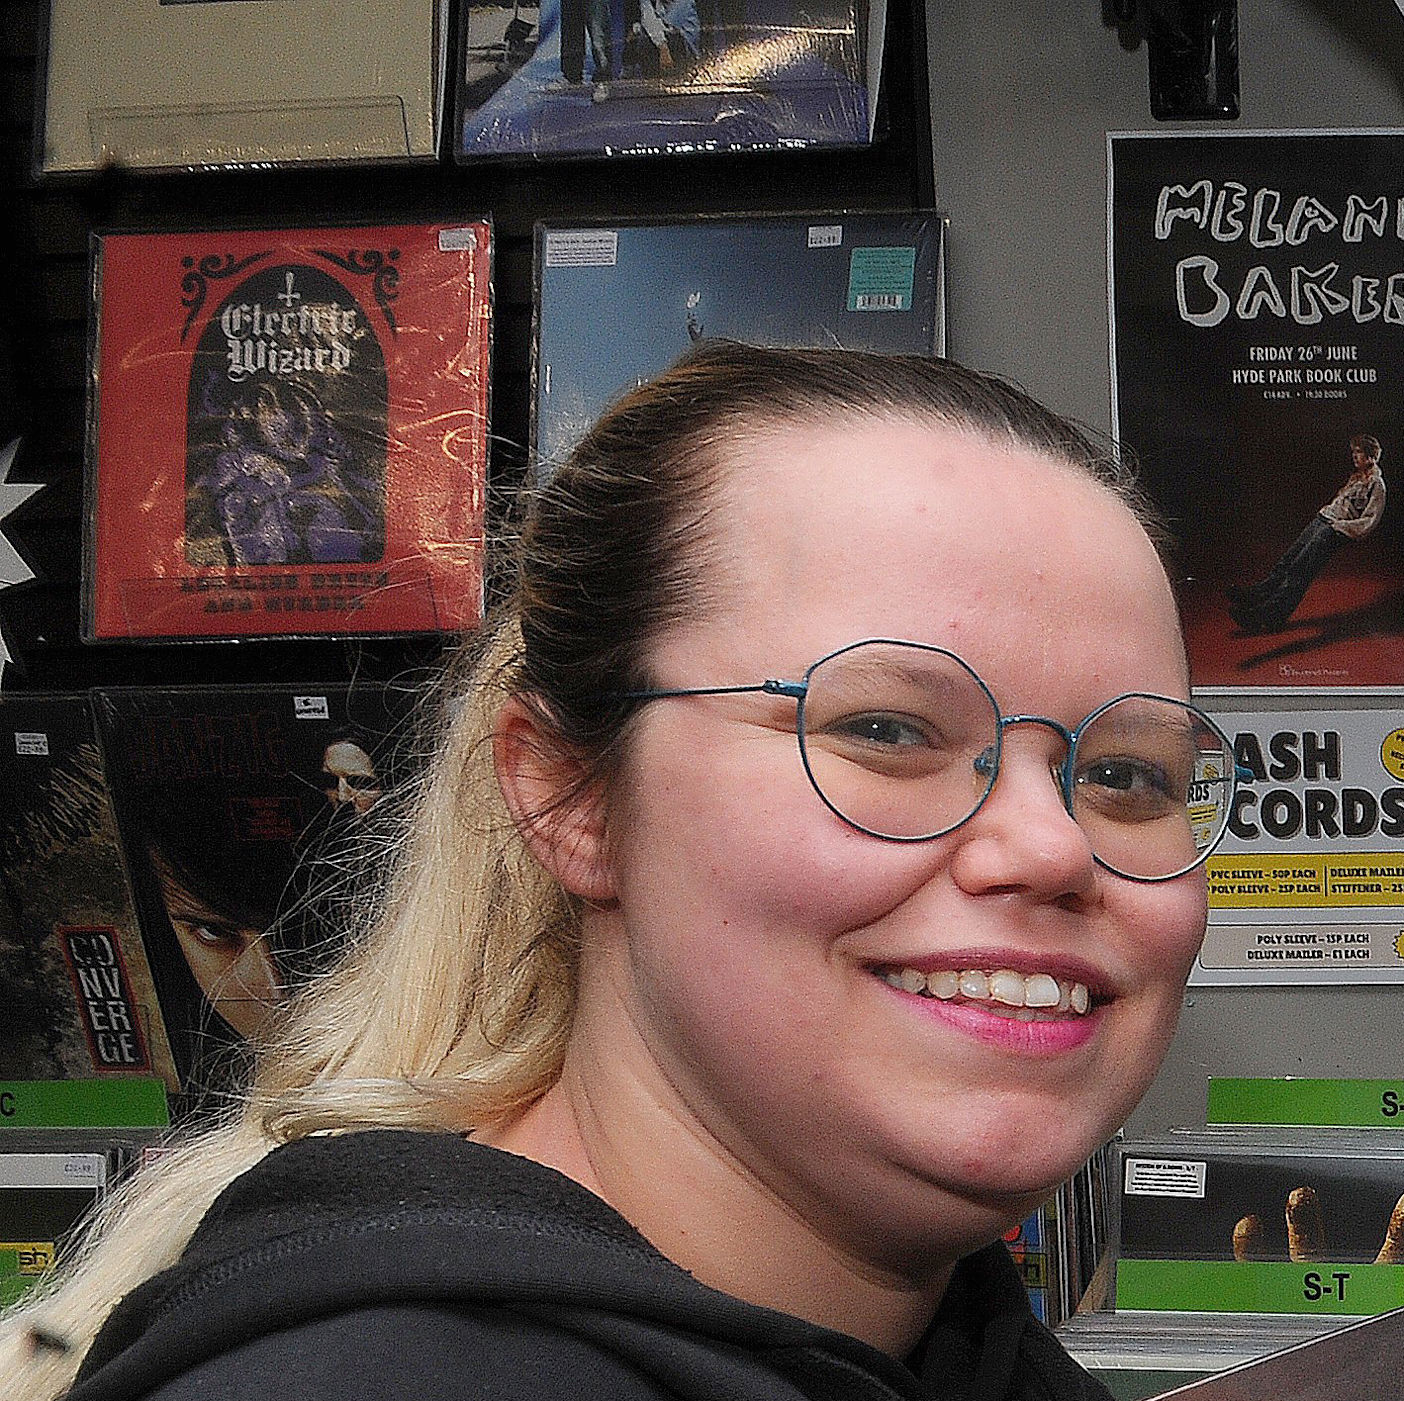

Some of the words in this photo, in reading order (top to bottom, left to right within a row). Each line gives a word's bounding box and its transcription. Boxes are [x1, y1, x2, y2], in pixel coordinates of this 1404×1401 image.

[220, 300, 360, 341] Electric
[226, 339, 354, 383] Wizard
[1250, 346, 1293, 362] FRIDAY
[1326, 346, 1358, 361] JUNE
[1232, 369, 1265, 384] HYDE
[1269, 369, 1302, 384] PARK
[1306, 369, 1342, 383] BOOK
[1346, 368, 1377, 383] CLUB
[1232, 731, 1342, 783] ASH
[1302, 1272, 1351, 1302] S-T
